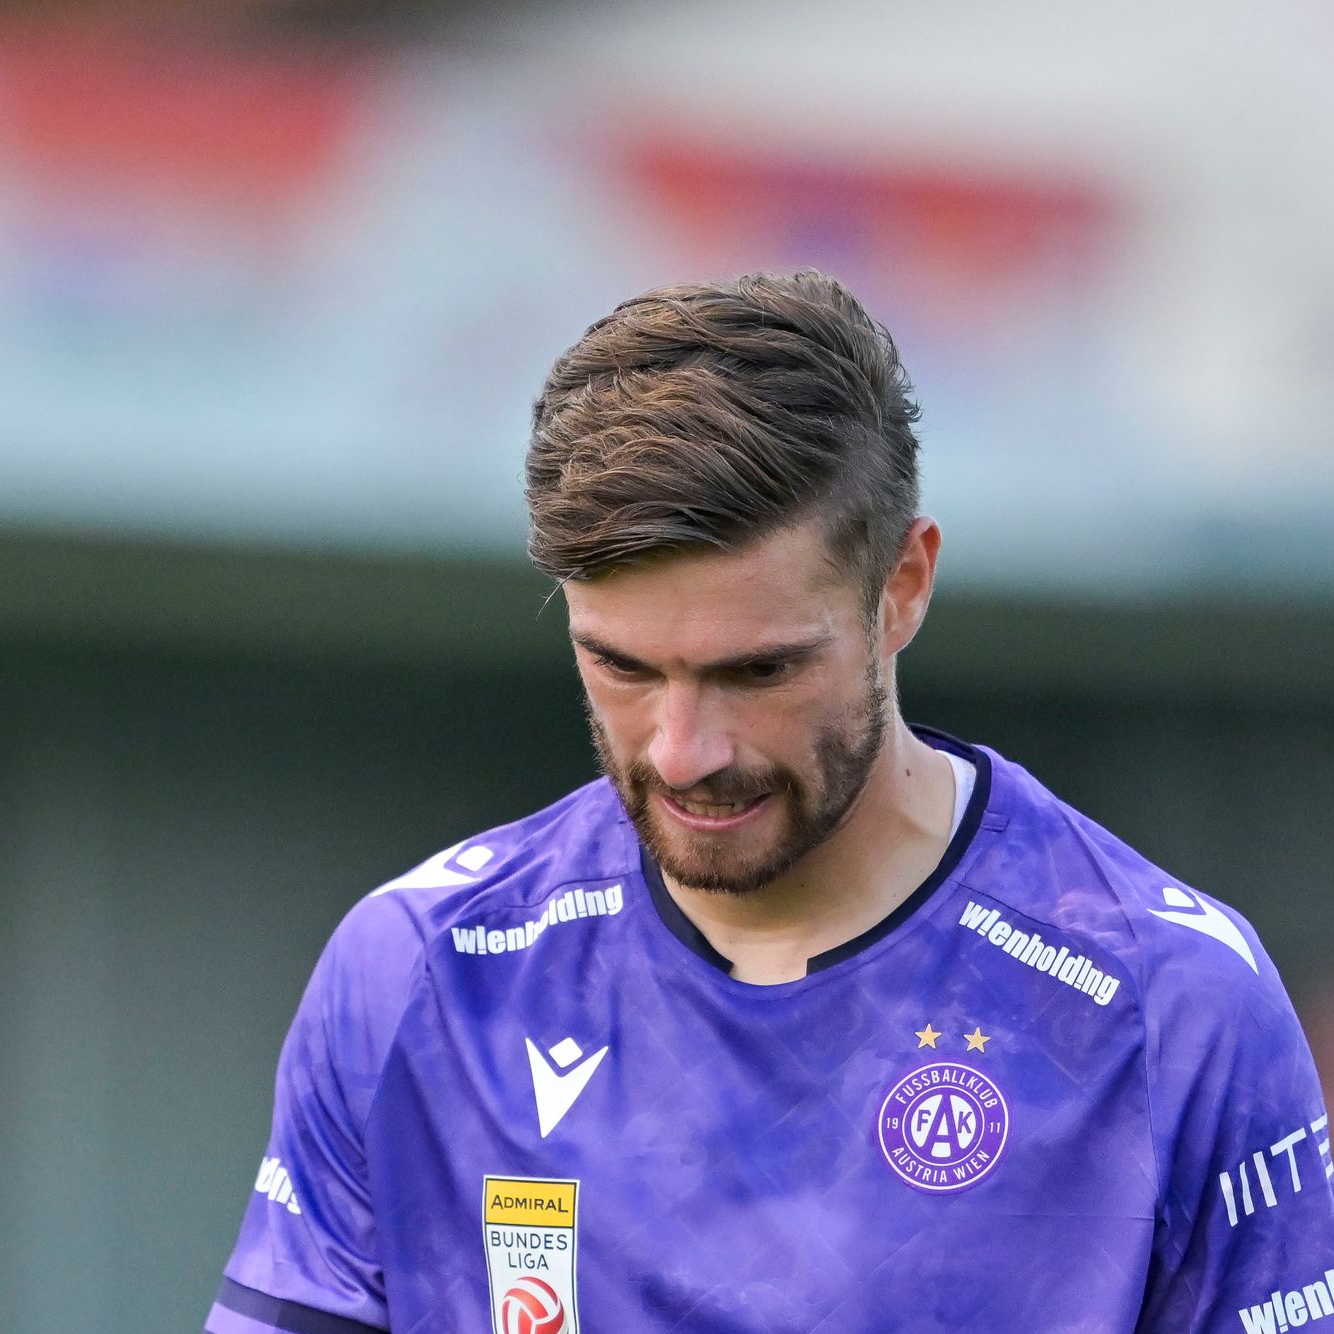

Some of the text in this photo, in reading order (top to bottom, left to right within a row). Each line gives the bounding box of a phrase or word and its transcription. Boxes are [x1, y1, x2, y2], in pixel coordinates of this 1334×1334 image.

[895, 1069, 998, 1108] FUSSBALLKLUB
[886, 1117, 899, 1129] 19
[989, 1122, 1001, 1133] 11
[892, 1147, 990, 1183] AUSTRIA WIEN
[490, 1231, 568, 1251] BUNDES
[508, 1252, 549, 1270] LIGA
